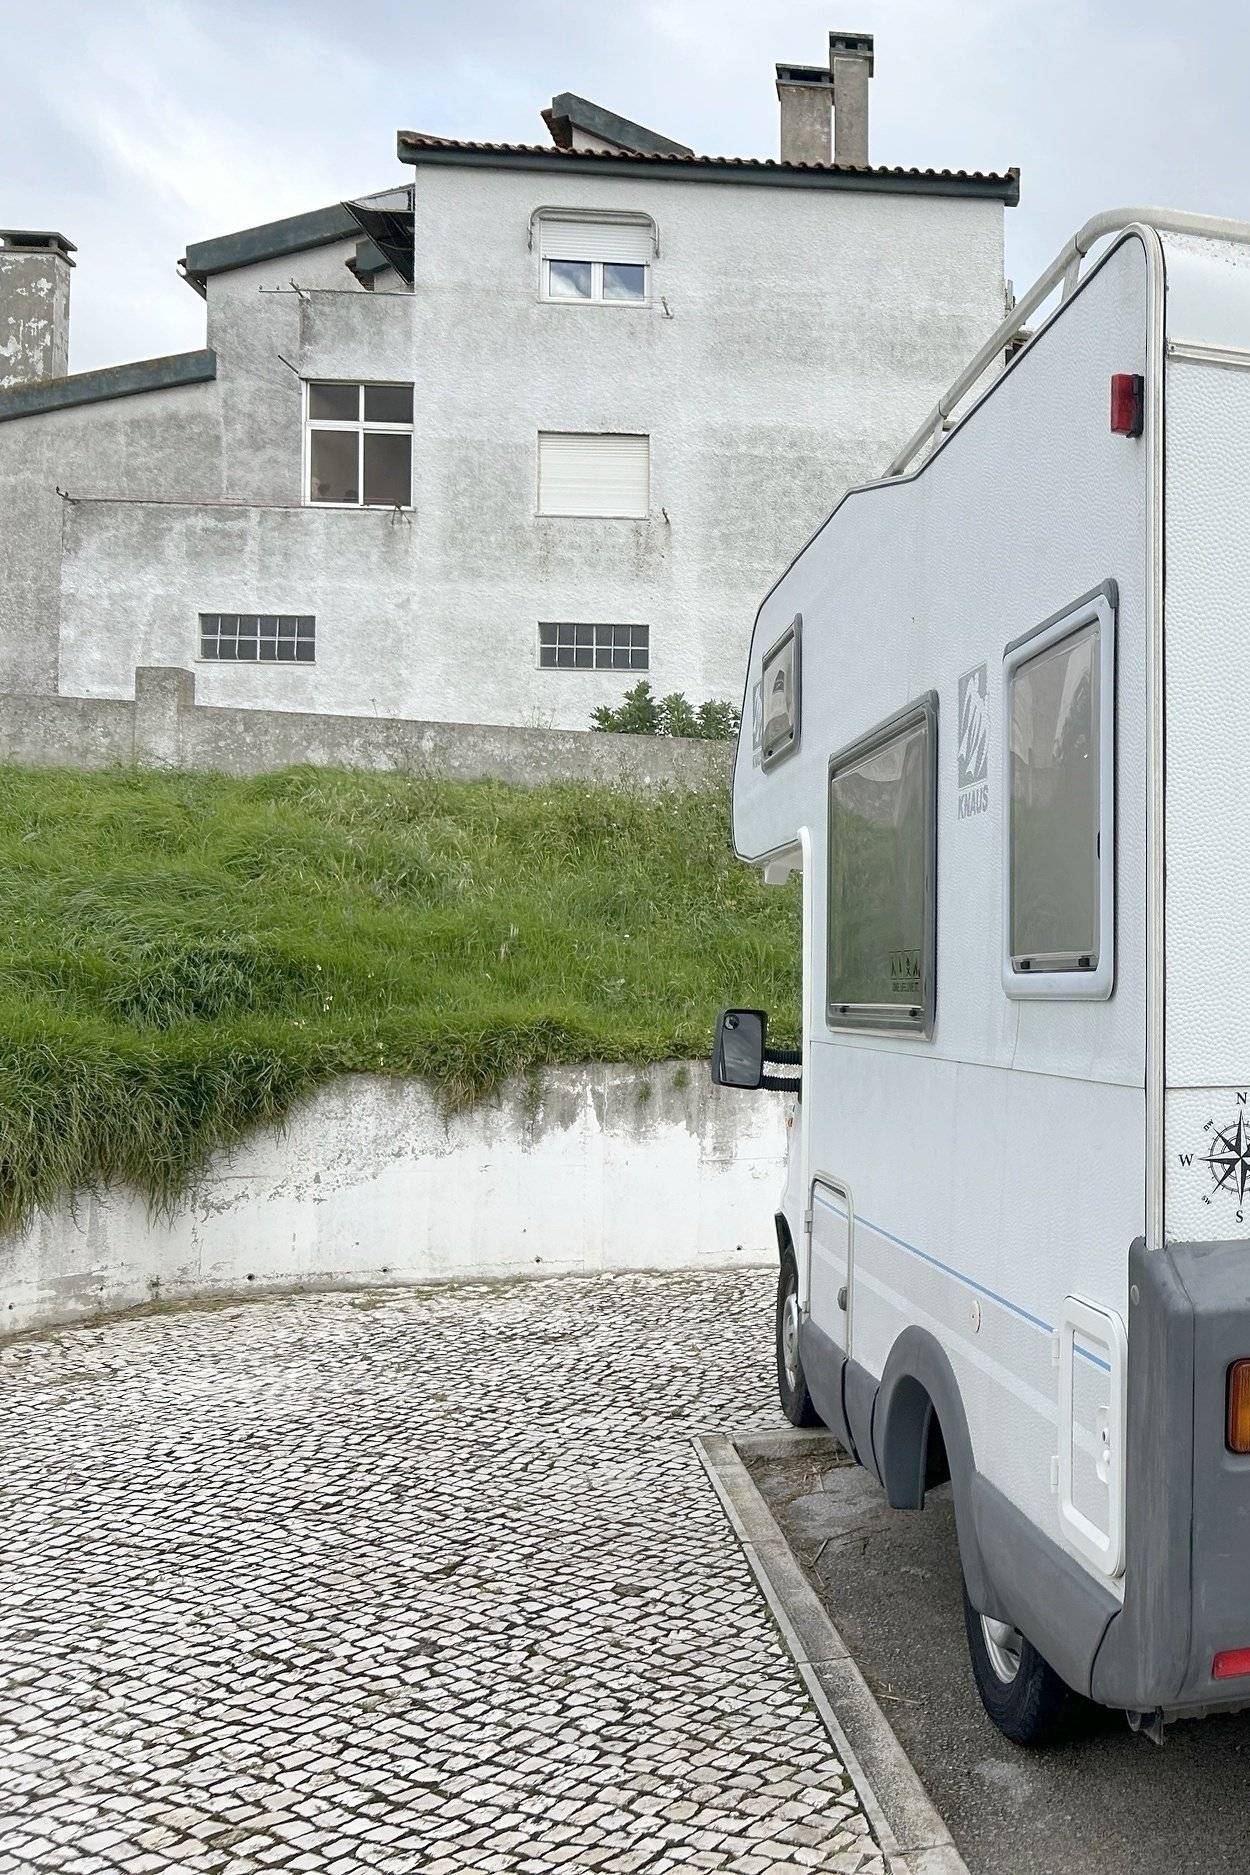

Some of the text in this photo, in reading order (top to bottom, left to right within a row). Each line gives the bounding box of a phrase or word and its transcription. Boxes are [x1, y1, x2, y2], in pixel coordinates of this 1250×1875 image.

[1236, 1092, 1247, 1105] N
[1179, 1154, 1194, 1166] W
[1236, 1210, 1244, 1223] S
